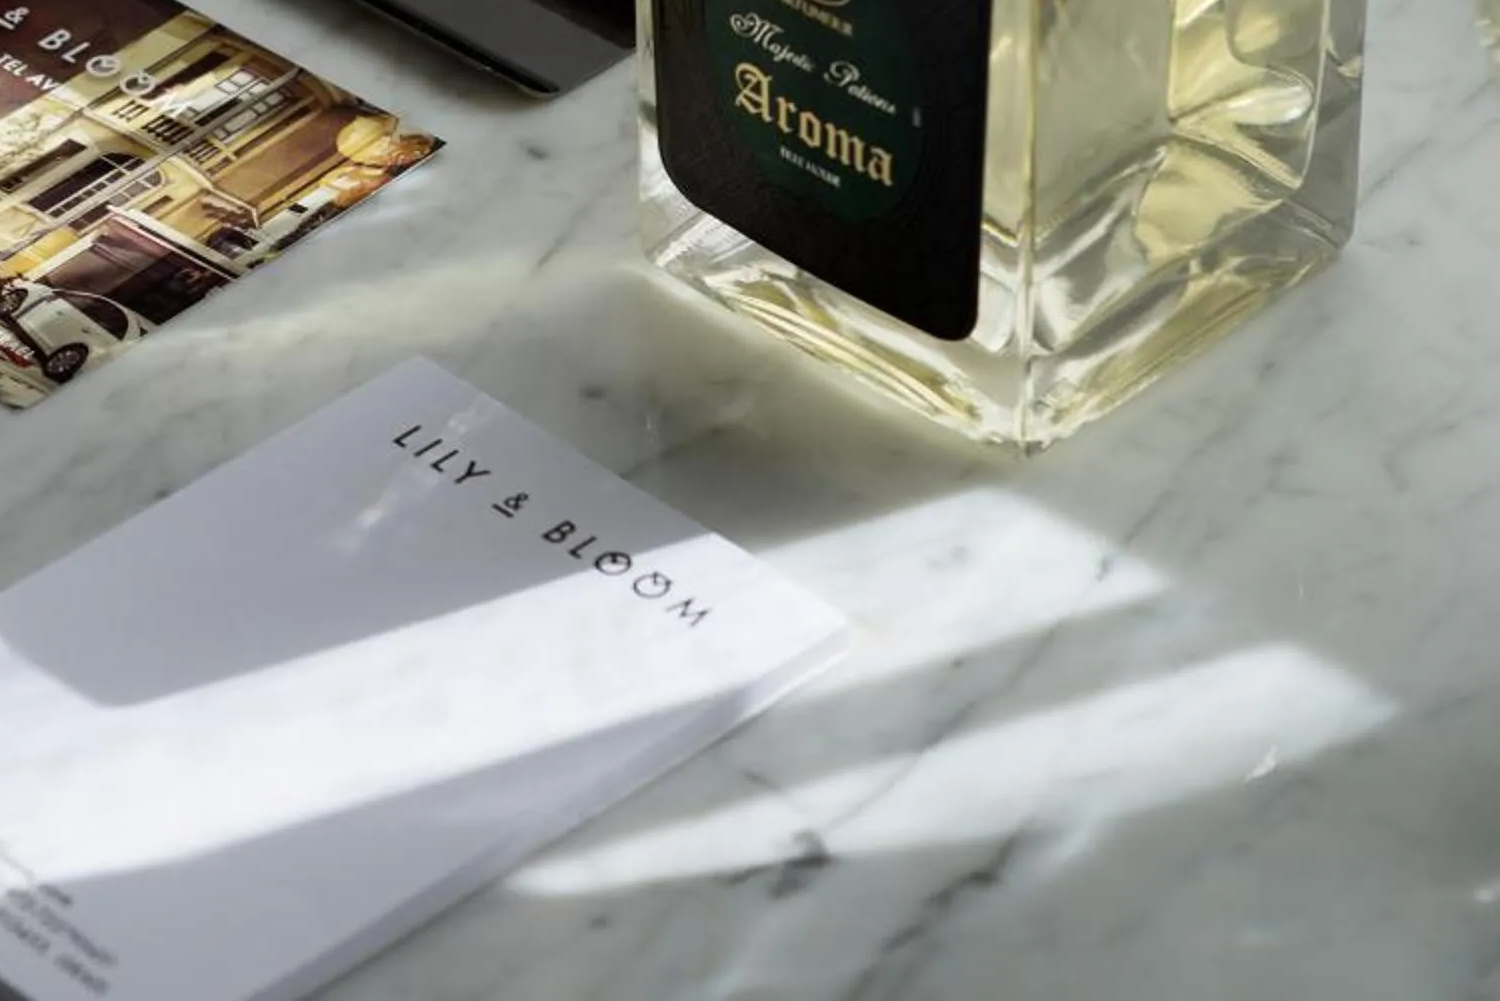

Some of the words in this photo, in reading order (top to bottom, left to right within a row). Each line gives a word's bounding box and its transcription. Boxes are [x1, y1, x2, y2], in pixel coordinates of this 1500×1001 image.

[37, 28, 190, 119] BLOOM
[734, 62, 893, 186] Aroma
[393, 425, 492, 485] LILY
[492, 492, 529, 518] &
[541, 520, 713, 627] BLOOM
